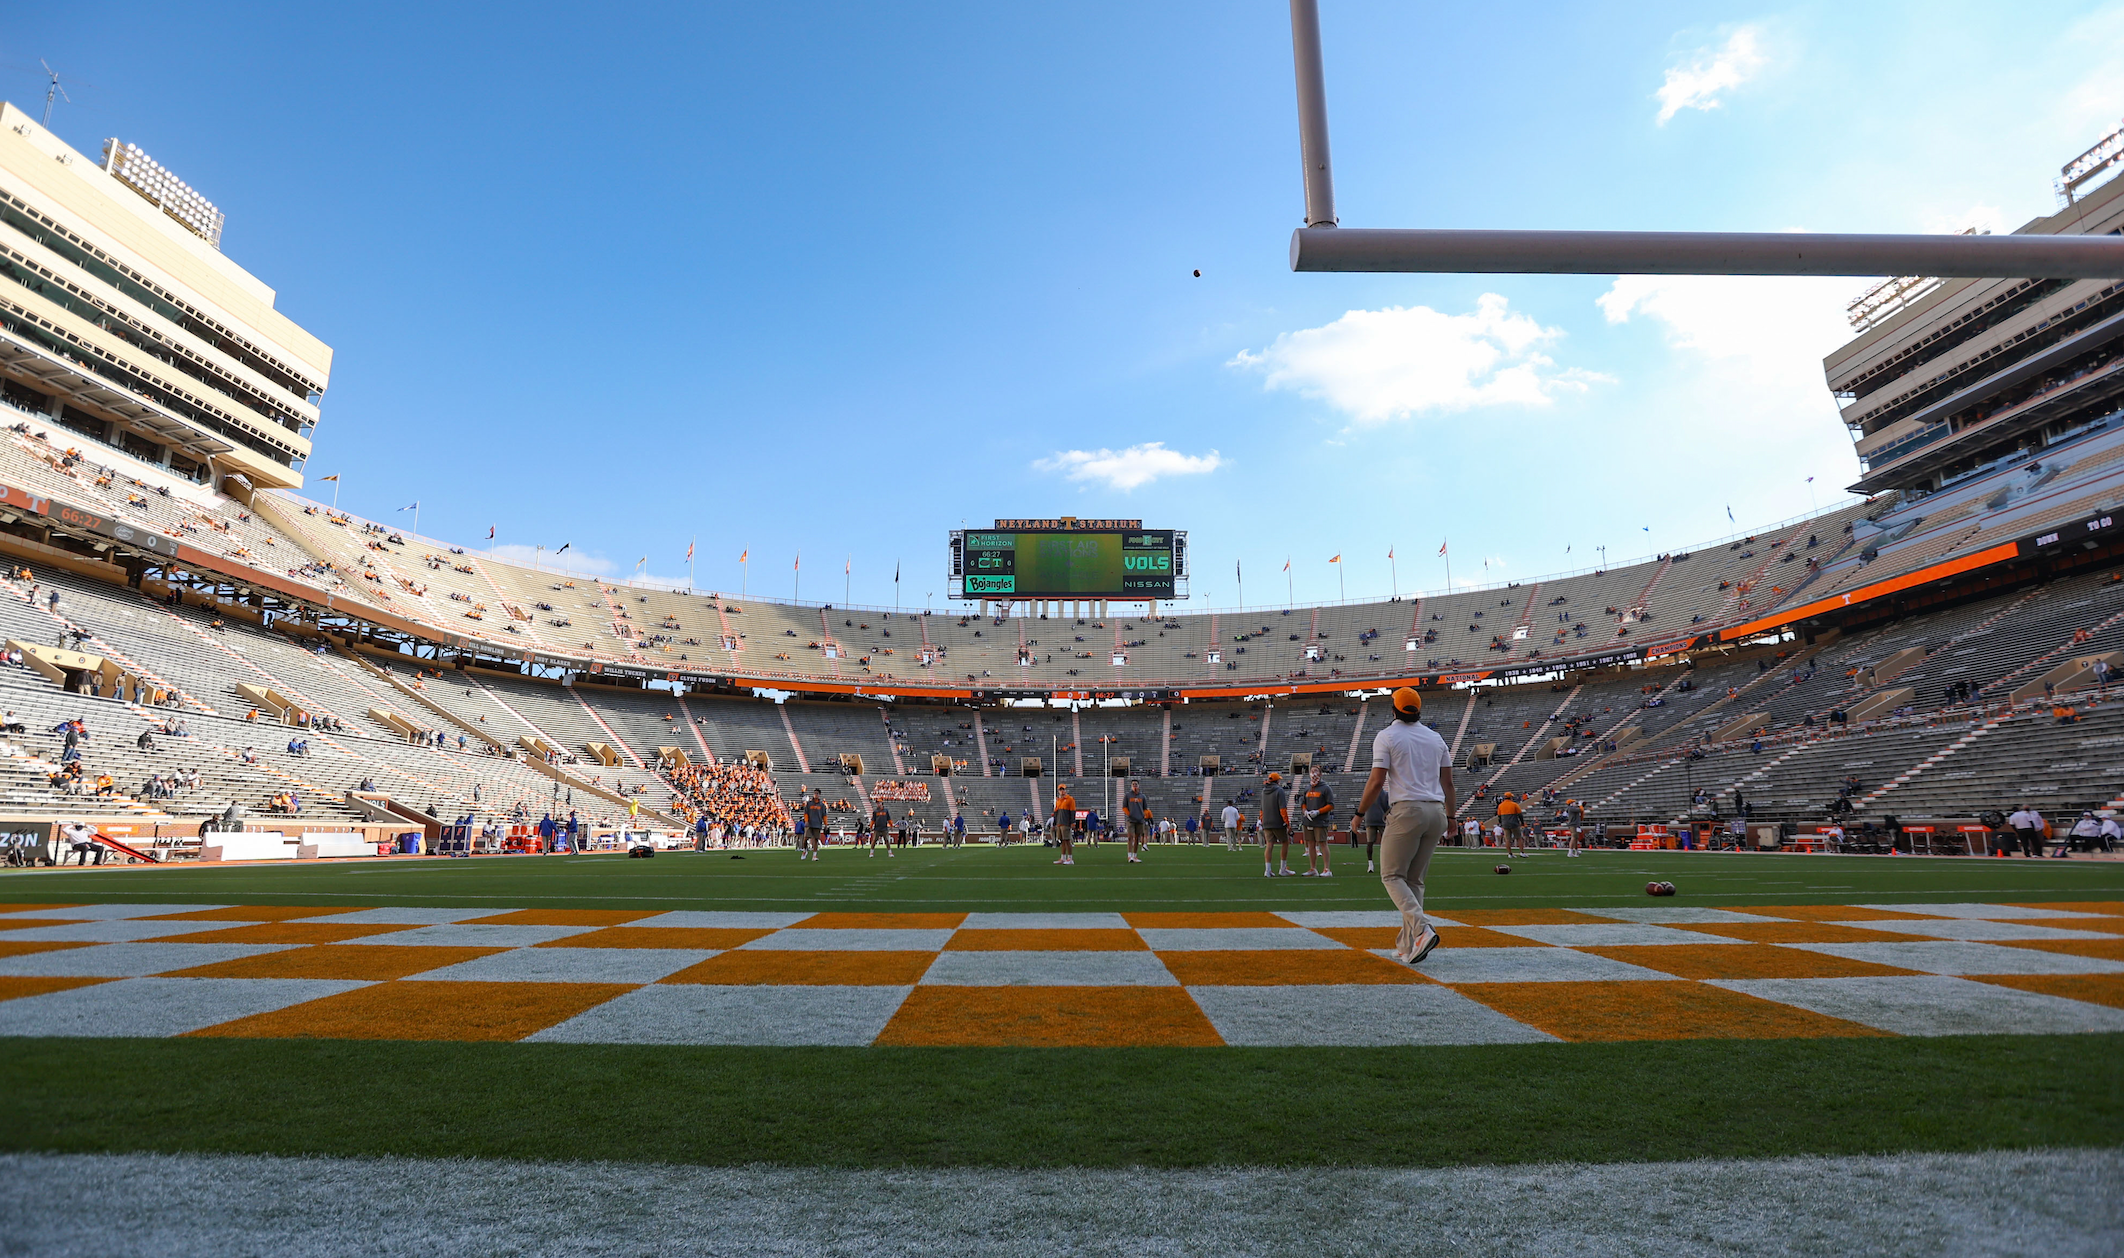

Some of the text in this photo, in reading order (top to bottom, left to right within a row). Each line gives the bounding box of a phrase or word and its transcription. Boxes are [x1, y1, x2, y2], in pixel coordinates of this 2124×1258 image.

[61, 508, 102, 529] 66:27
[147, 536, 157, 547] 0
[1000, 517, 1138, 530] NEYLAND T STADIUM
[1039, 541, 1099, 550] FIRST AID
[1125, 556, 1169, 570] VOLS
[969, 577, 1013, 591] Bojangles
[1651, 641, 1688, 655] CHAMPIONS
[1446, 674, 1480, 682] NATIONAL
